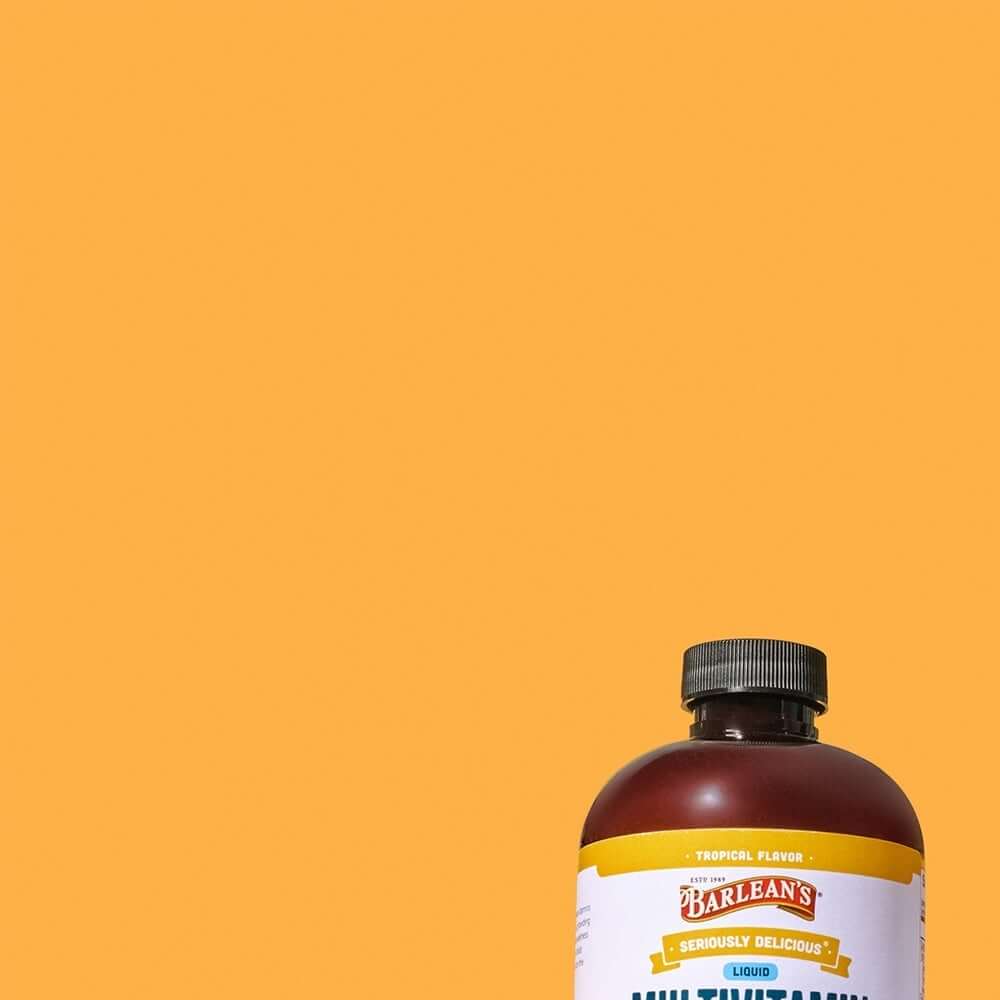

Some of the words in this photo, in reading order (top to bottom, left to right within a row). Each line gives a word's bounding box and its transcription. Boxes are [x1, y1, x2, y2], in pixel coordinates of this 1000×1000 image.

[695, 850, 753, 862] TROPICAL
[757, 851, 803, 863] FLAVOR
[680, 879, 812, 918] BARLEAN'S
[679, 935, 750, 953] SERIOUSLY
[732, 966, 770, 977] LIQUID
